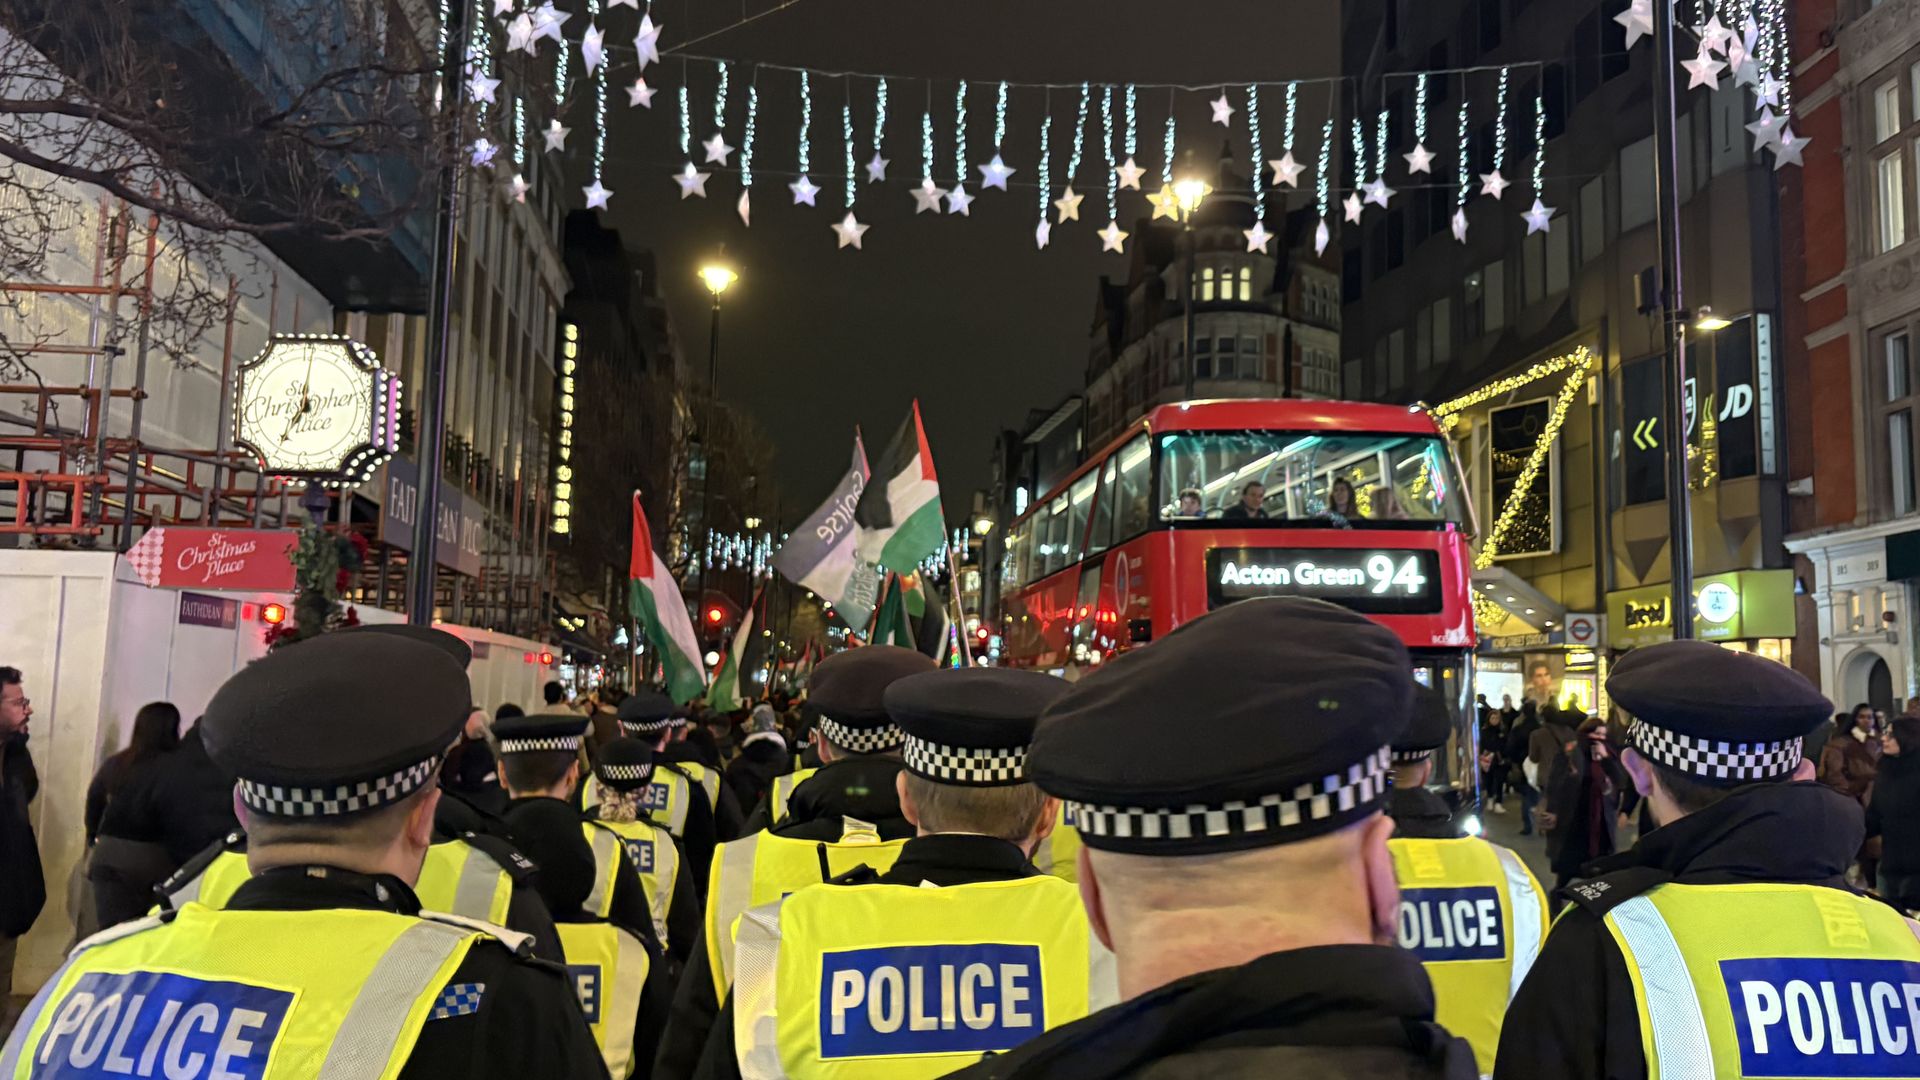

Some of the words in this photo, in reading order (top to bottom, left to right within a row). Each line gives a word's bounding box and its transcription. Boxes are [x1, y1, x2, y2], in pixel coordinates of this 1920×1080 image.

[1719, 384, 1753, 422] JD
[177, 540, 257, 571] Christmas
[208, 532, 227, 547] St
[202, 559, 245, 583] Place
[1221, 562, 1291, 585] Acton
[1294, 562, 1365, 585] Green
[1367, 554, 1426, 594] 94
[1399, 899, 1498, 949] OLICE
[831, 962, 1033, 1035] POLICE
[39, 991, 268, 1080] POLICE
